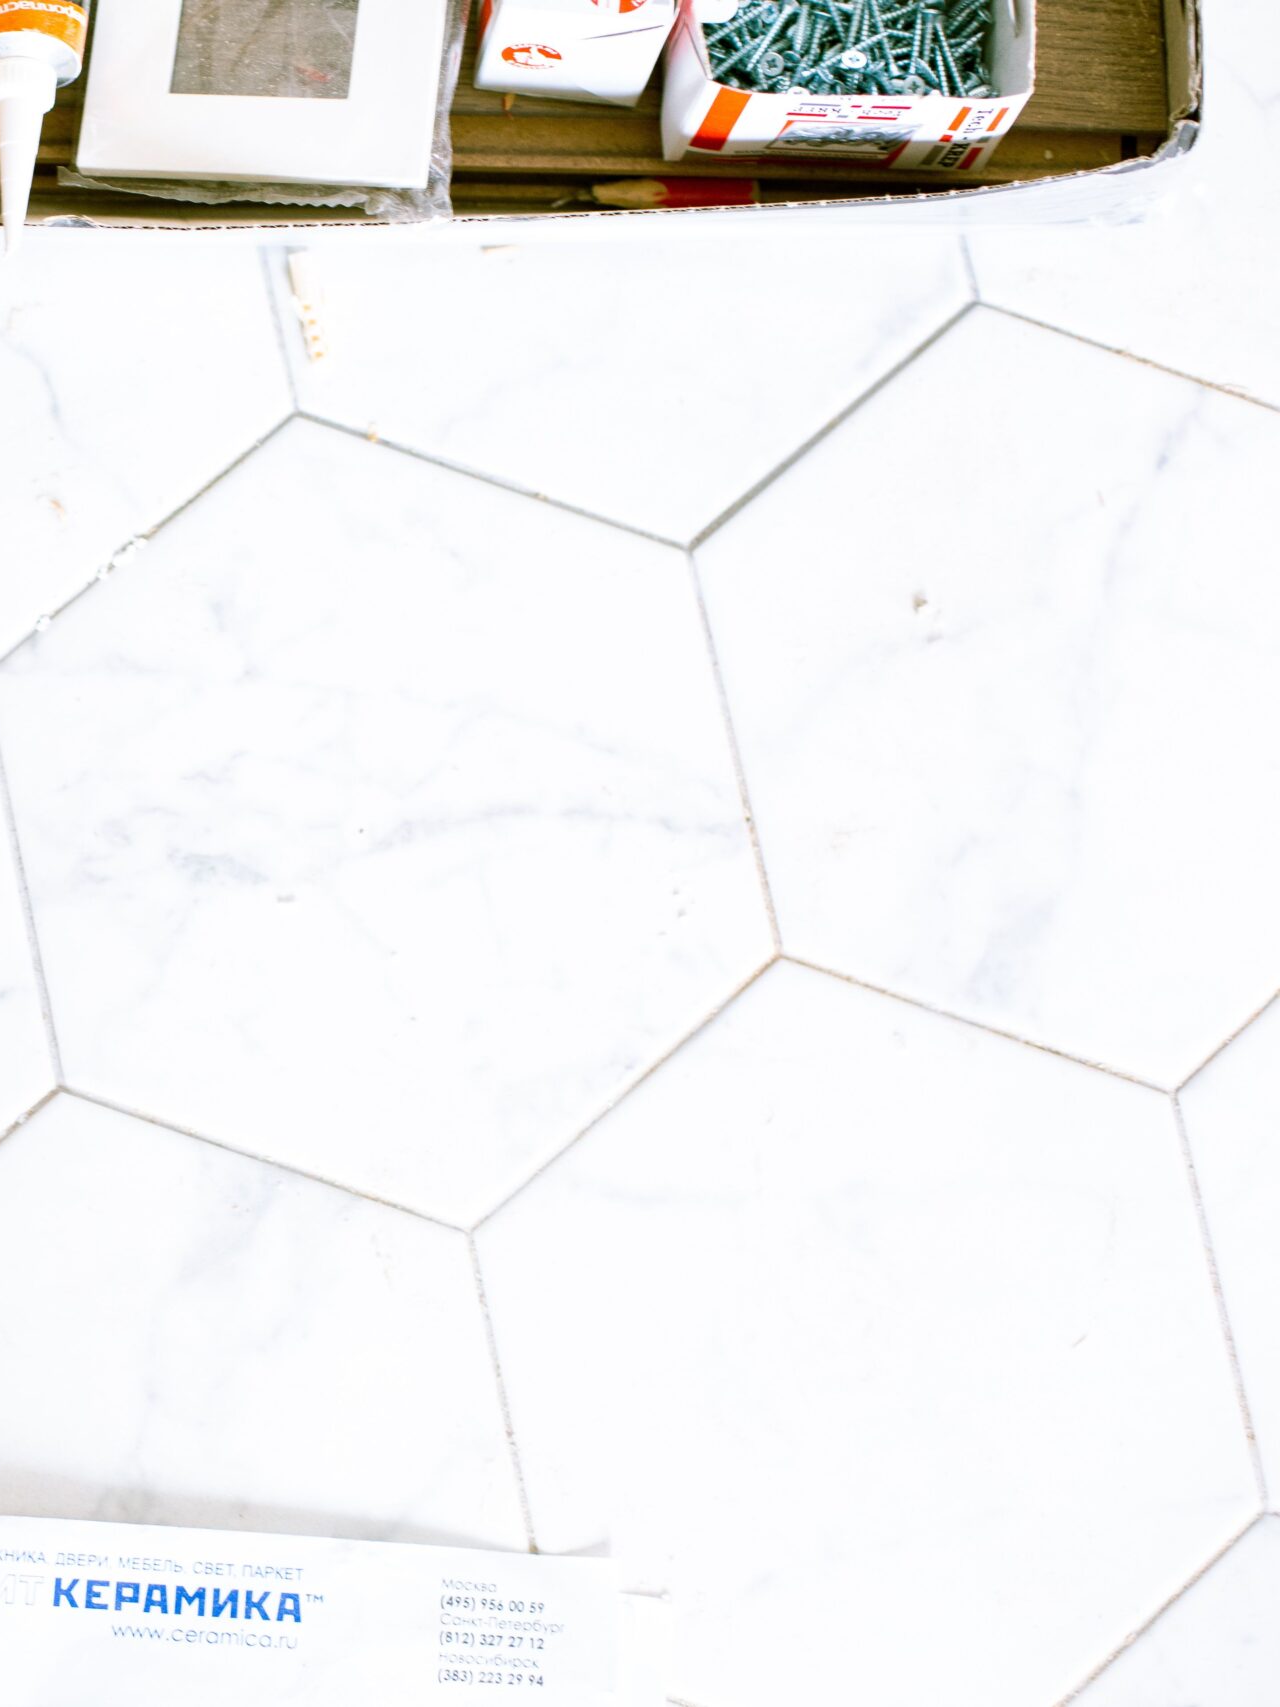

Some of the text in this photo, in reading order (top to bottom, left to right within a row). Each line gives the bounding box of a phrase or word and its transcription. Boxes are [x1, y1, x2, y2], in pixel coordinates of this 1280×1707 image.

[242, 1563, 304, 1582] ПАРКЕТ
[440, 1577, 498, 1593] Москва
[440, 1595, 545, 1614] (495) 956 00 59
[439, 1612, 566, 1635] Санкт-Петербург
[111, 1624, 299, 1650] www.ceramica.ru
[439, 1630, 545, 1650] (812) 327 27 12
[438, 1652, 540, 1671] Новосибирск
[437, 1668, 545, 1687] (383) 223 29 94
